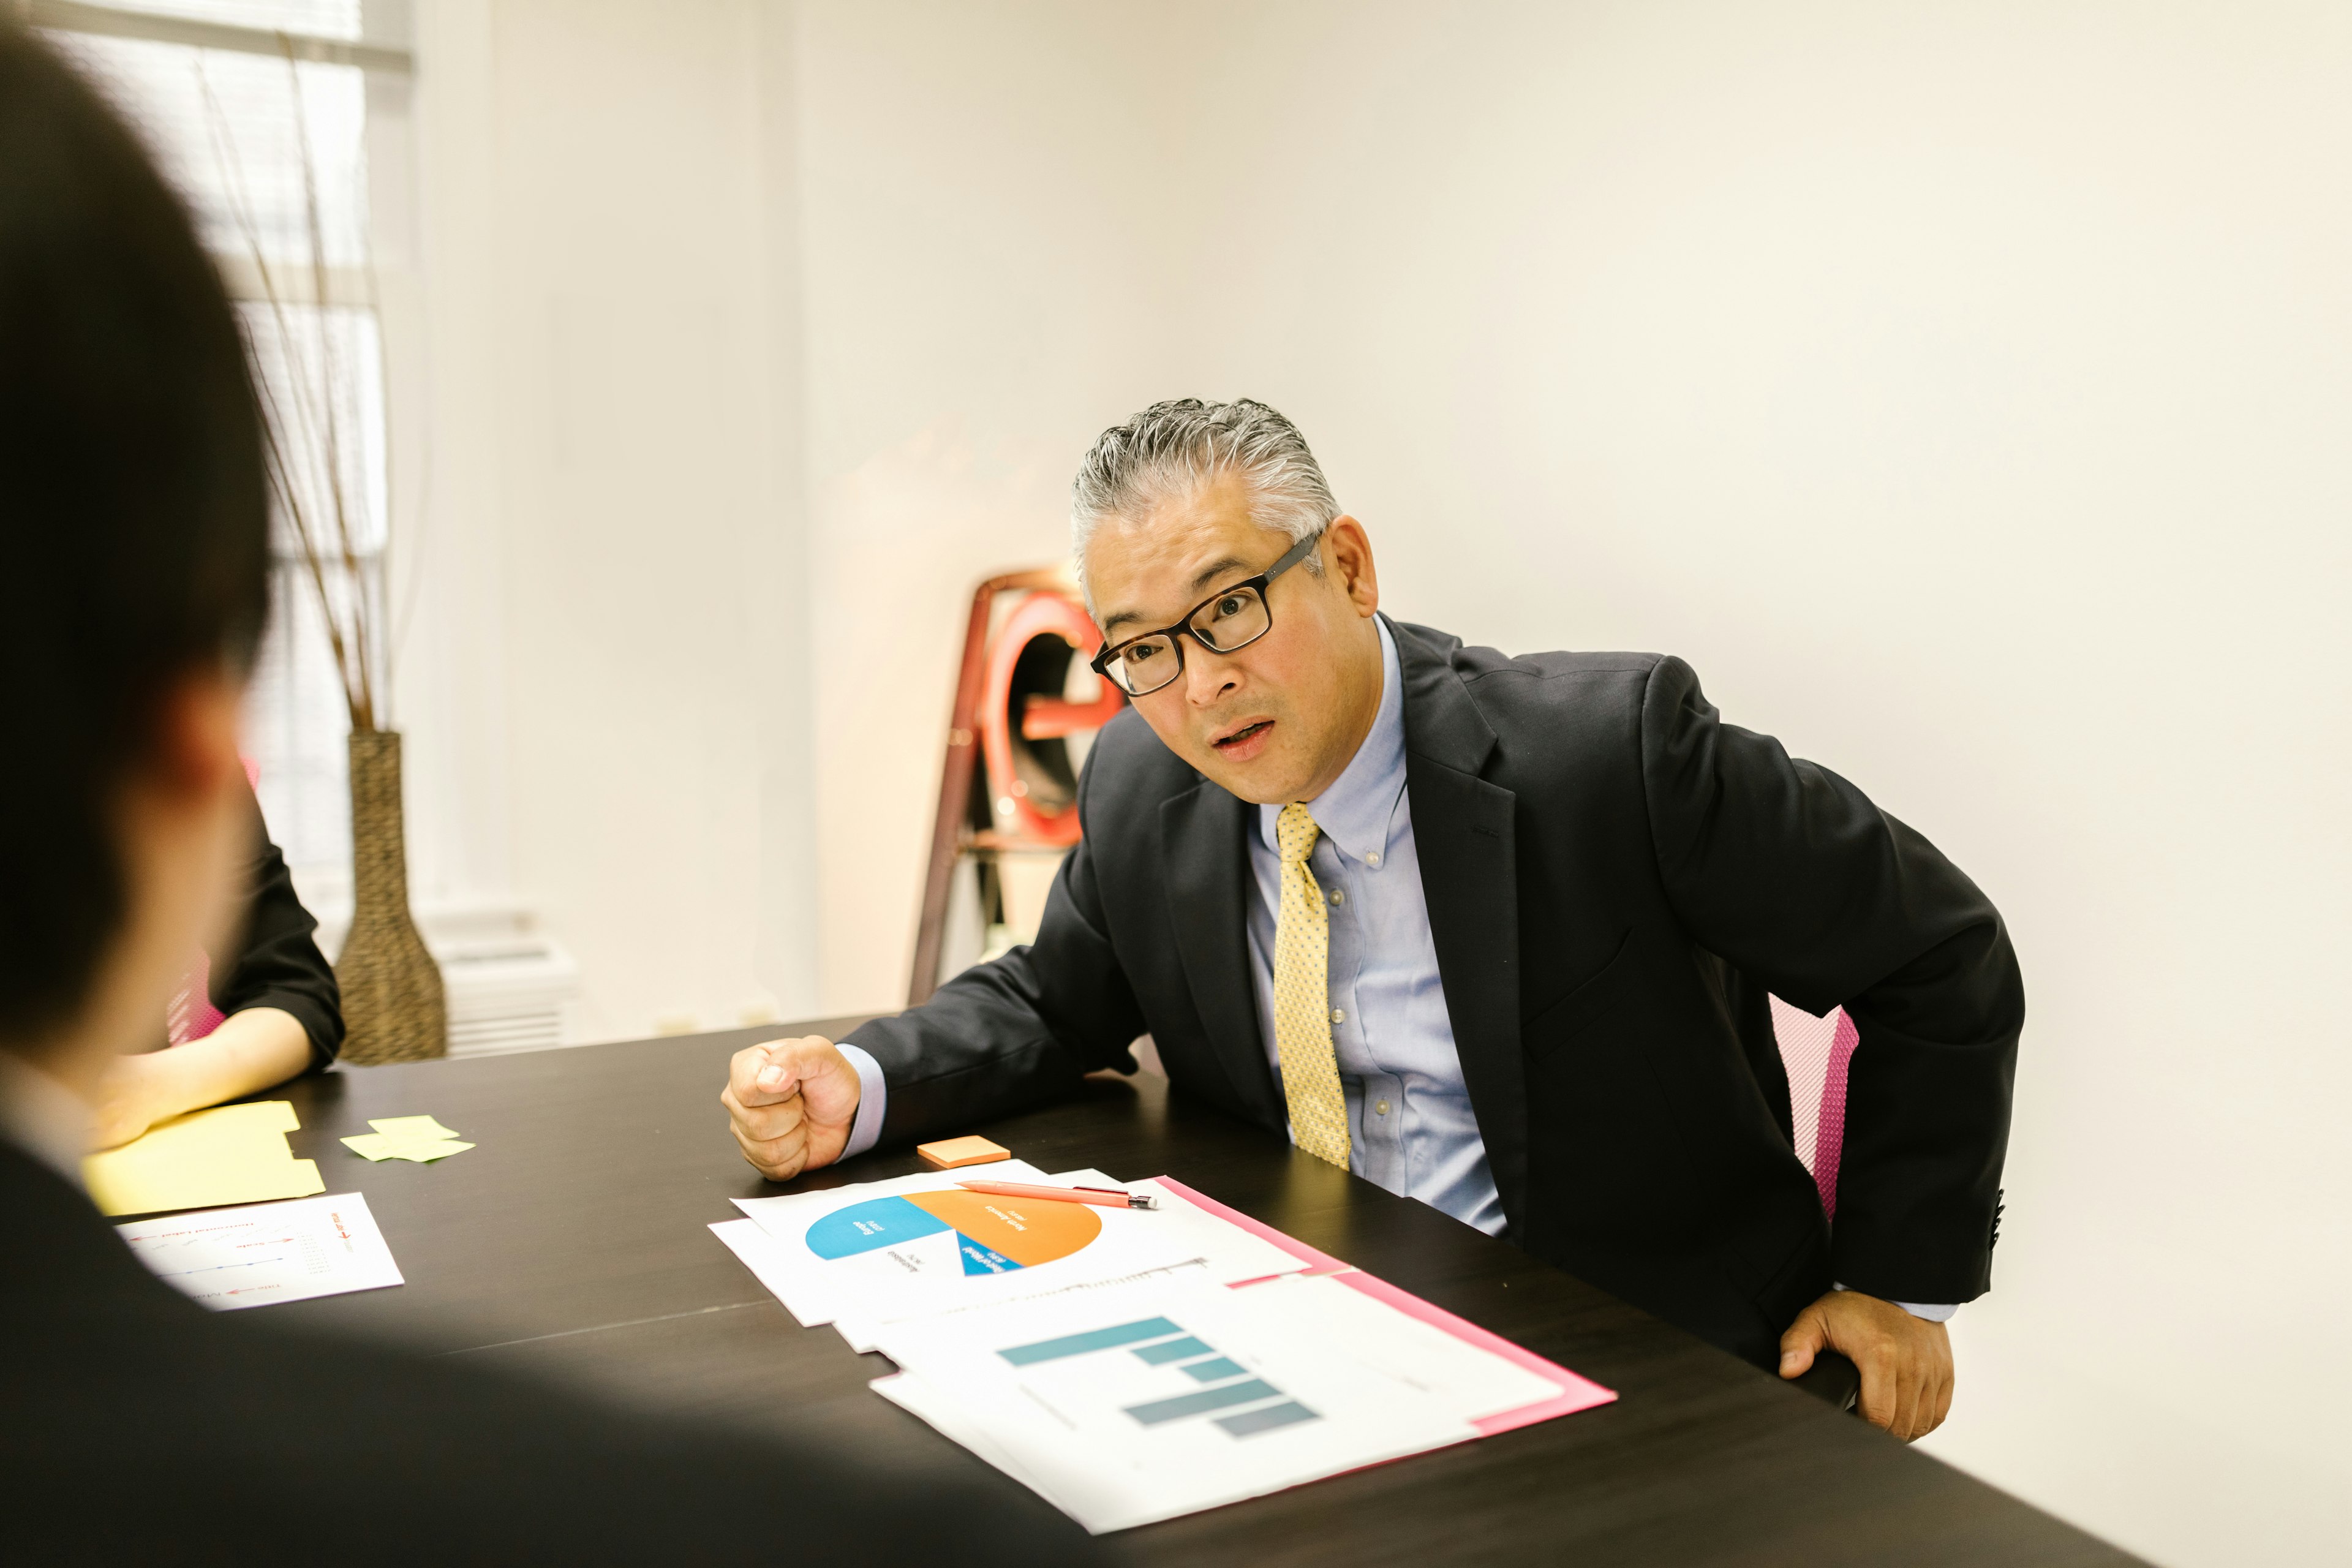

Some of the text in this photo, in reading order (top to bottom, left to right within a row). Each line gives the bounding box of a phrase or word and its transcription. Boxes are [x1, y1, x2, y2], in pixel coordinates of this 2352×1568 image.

[984, 1205, 1028, 1231] North America
[195, 1223, 254, 1233] Horizontal
[852, 1221, 874, 1235] Europe
